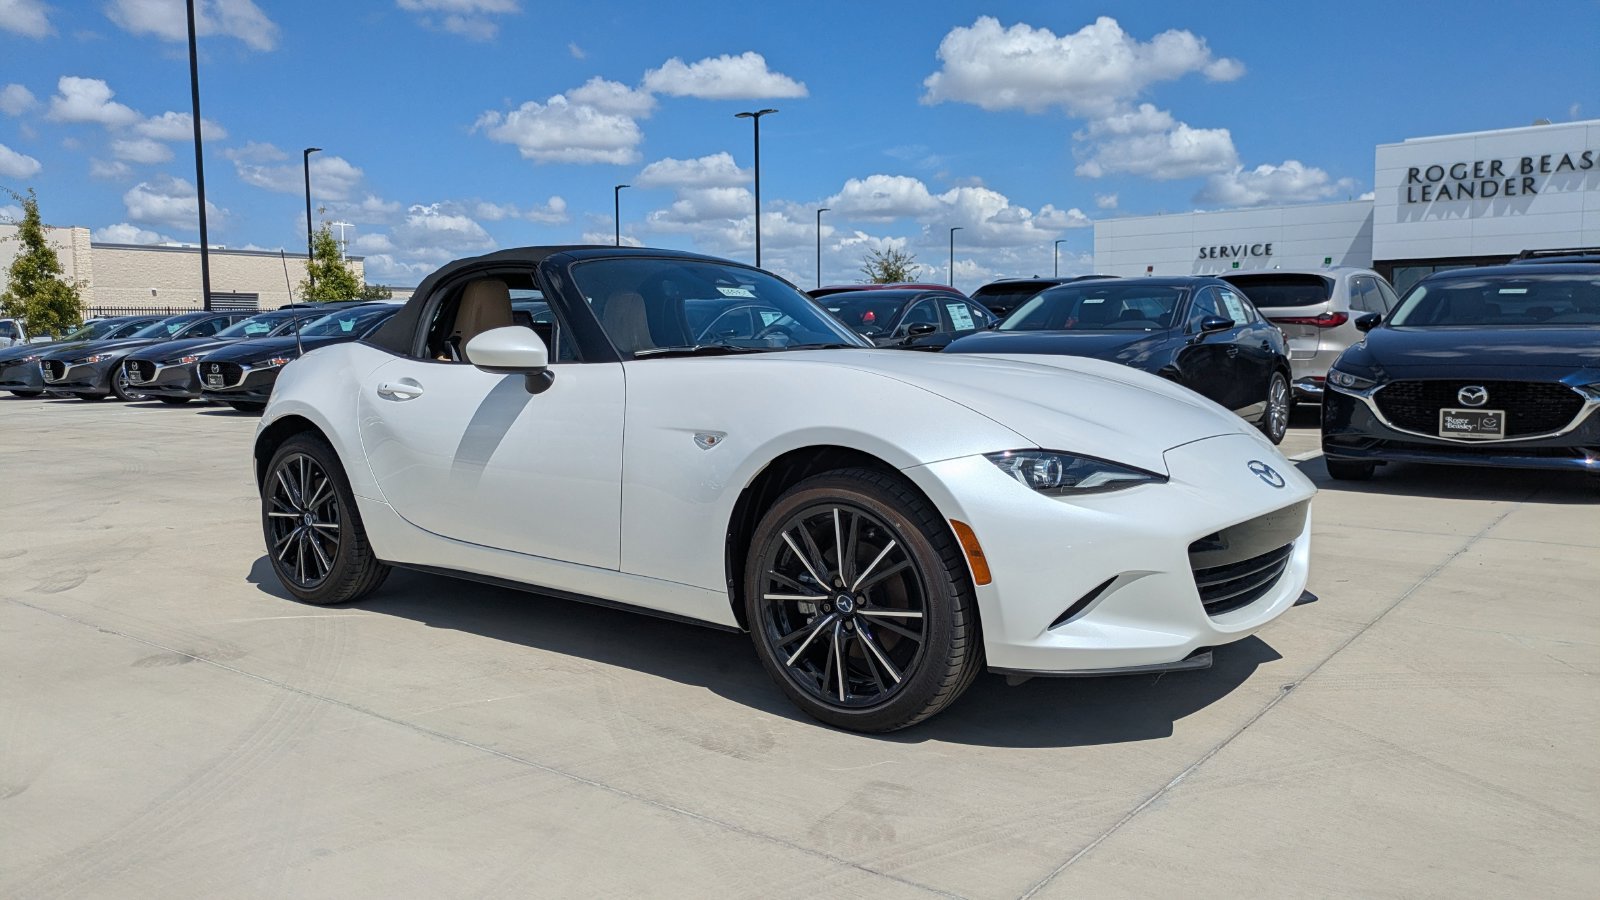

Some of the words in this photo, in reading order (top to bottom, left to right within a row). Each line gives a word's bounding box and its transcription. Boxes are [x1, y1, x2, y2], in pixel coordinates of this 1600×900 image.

[1407, 159, 1506, 184] ROGER
[1407, 176, 1538, 204] LEANDER
[1198, 243, 1273, 259] SERVICE
